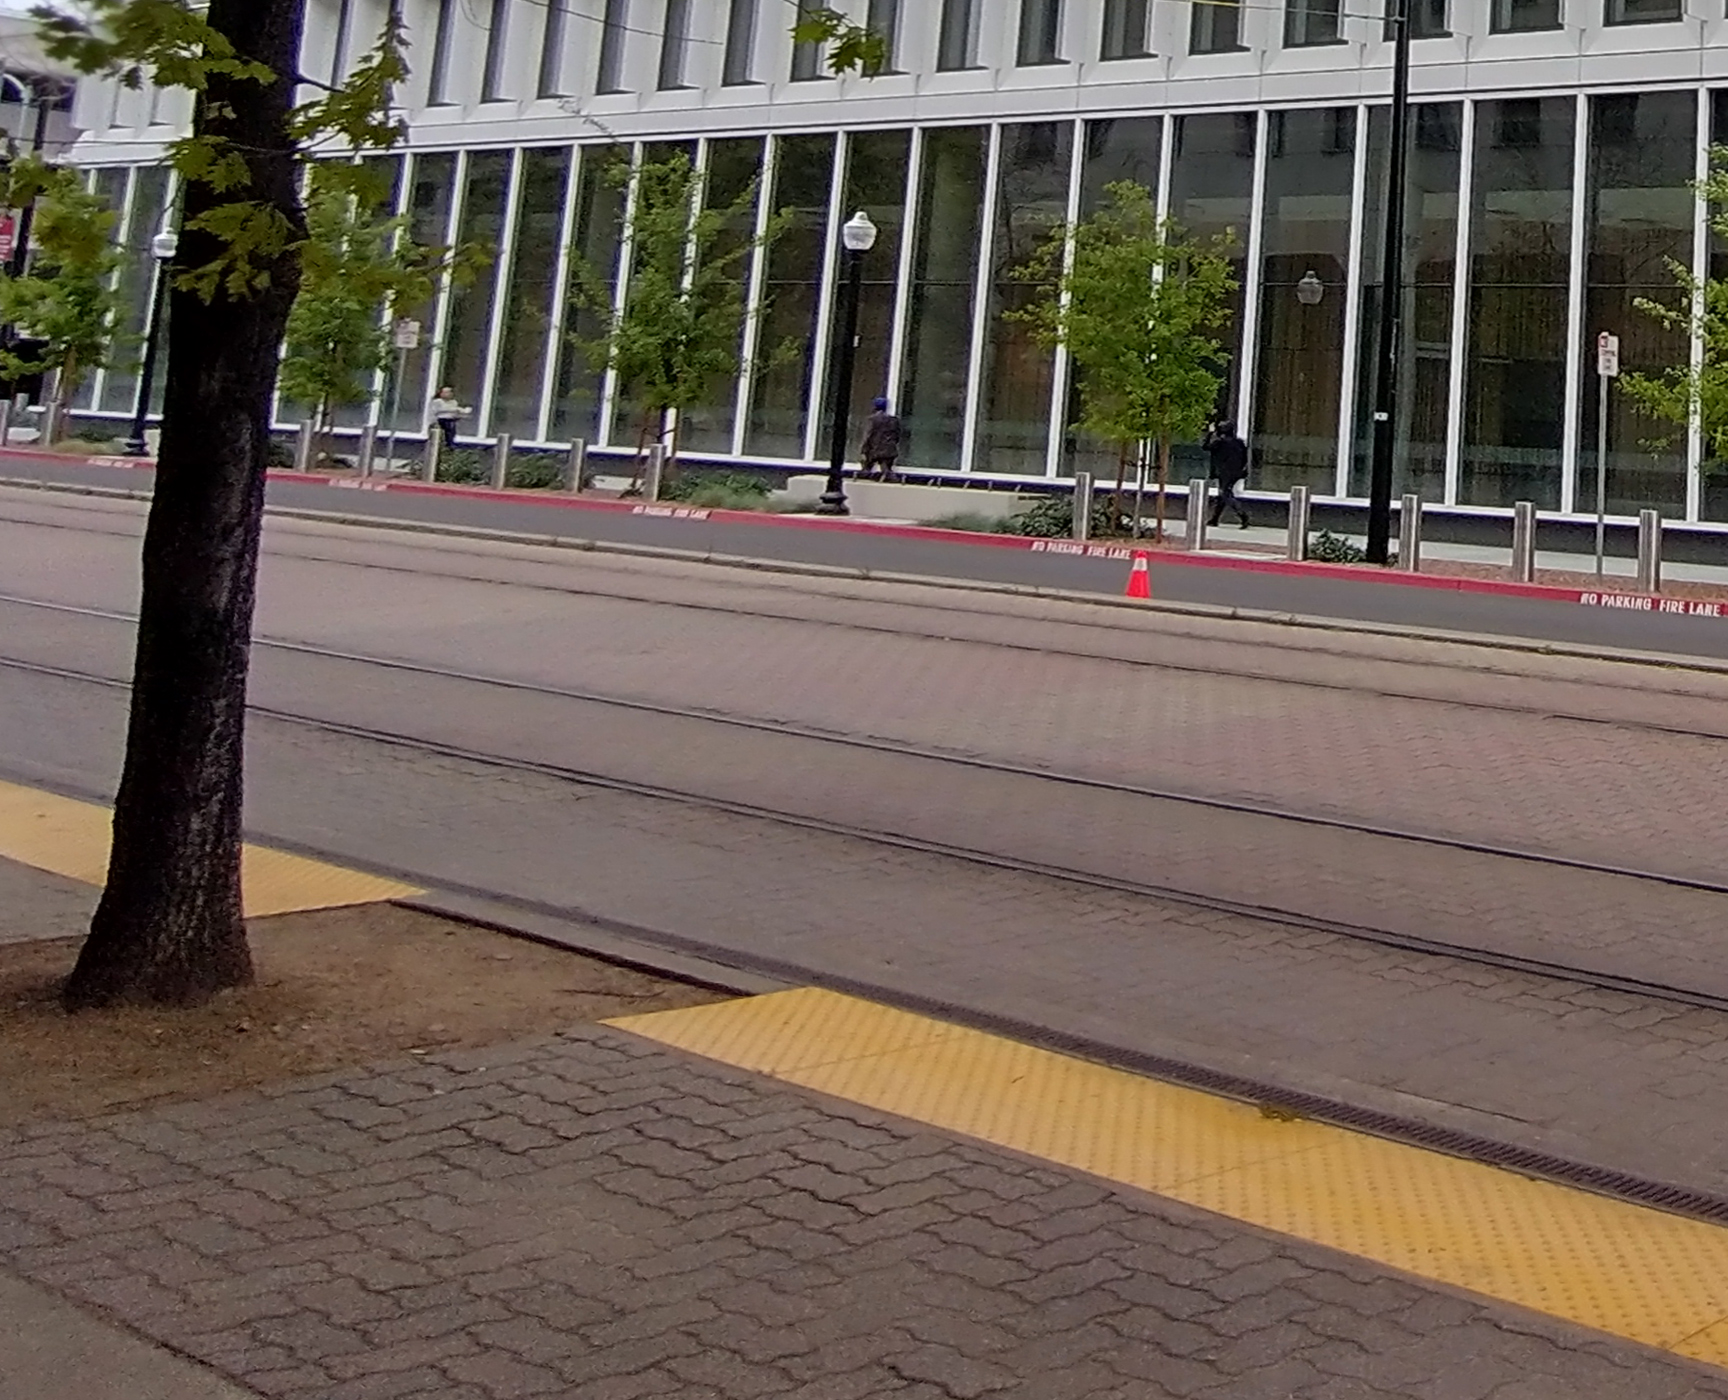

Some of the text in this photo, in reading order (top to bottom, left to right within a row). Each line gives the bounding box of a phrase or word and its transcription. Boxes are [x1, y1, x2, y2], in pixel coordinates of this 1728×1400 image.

[1580, 593, 1721, 617] NO PARKING FIRE LANE
